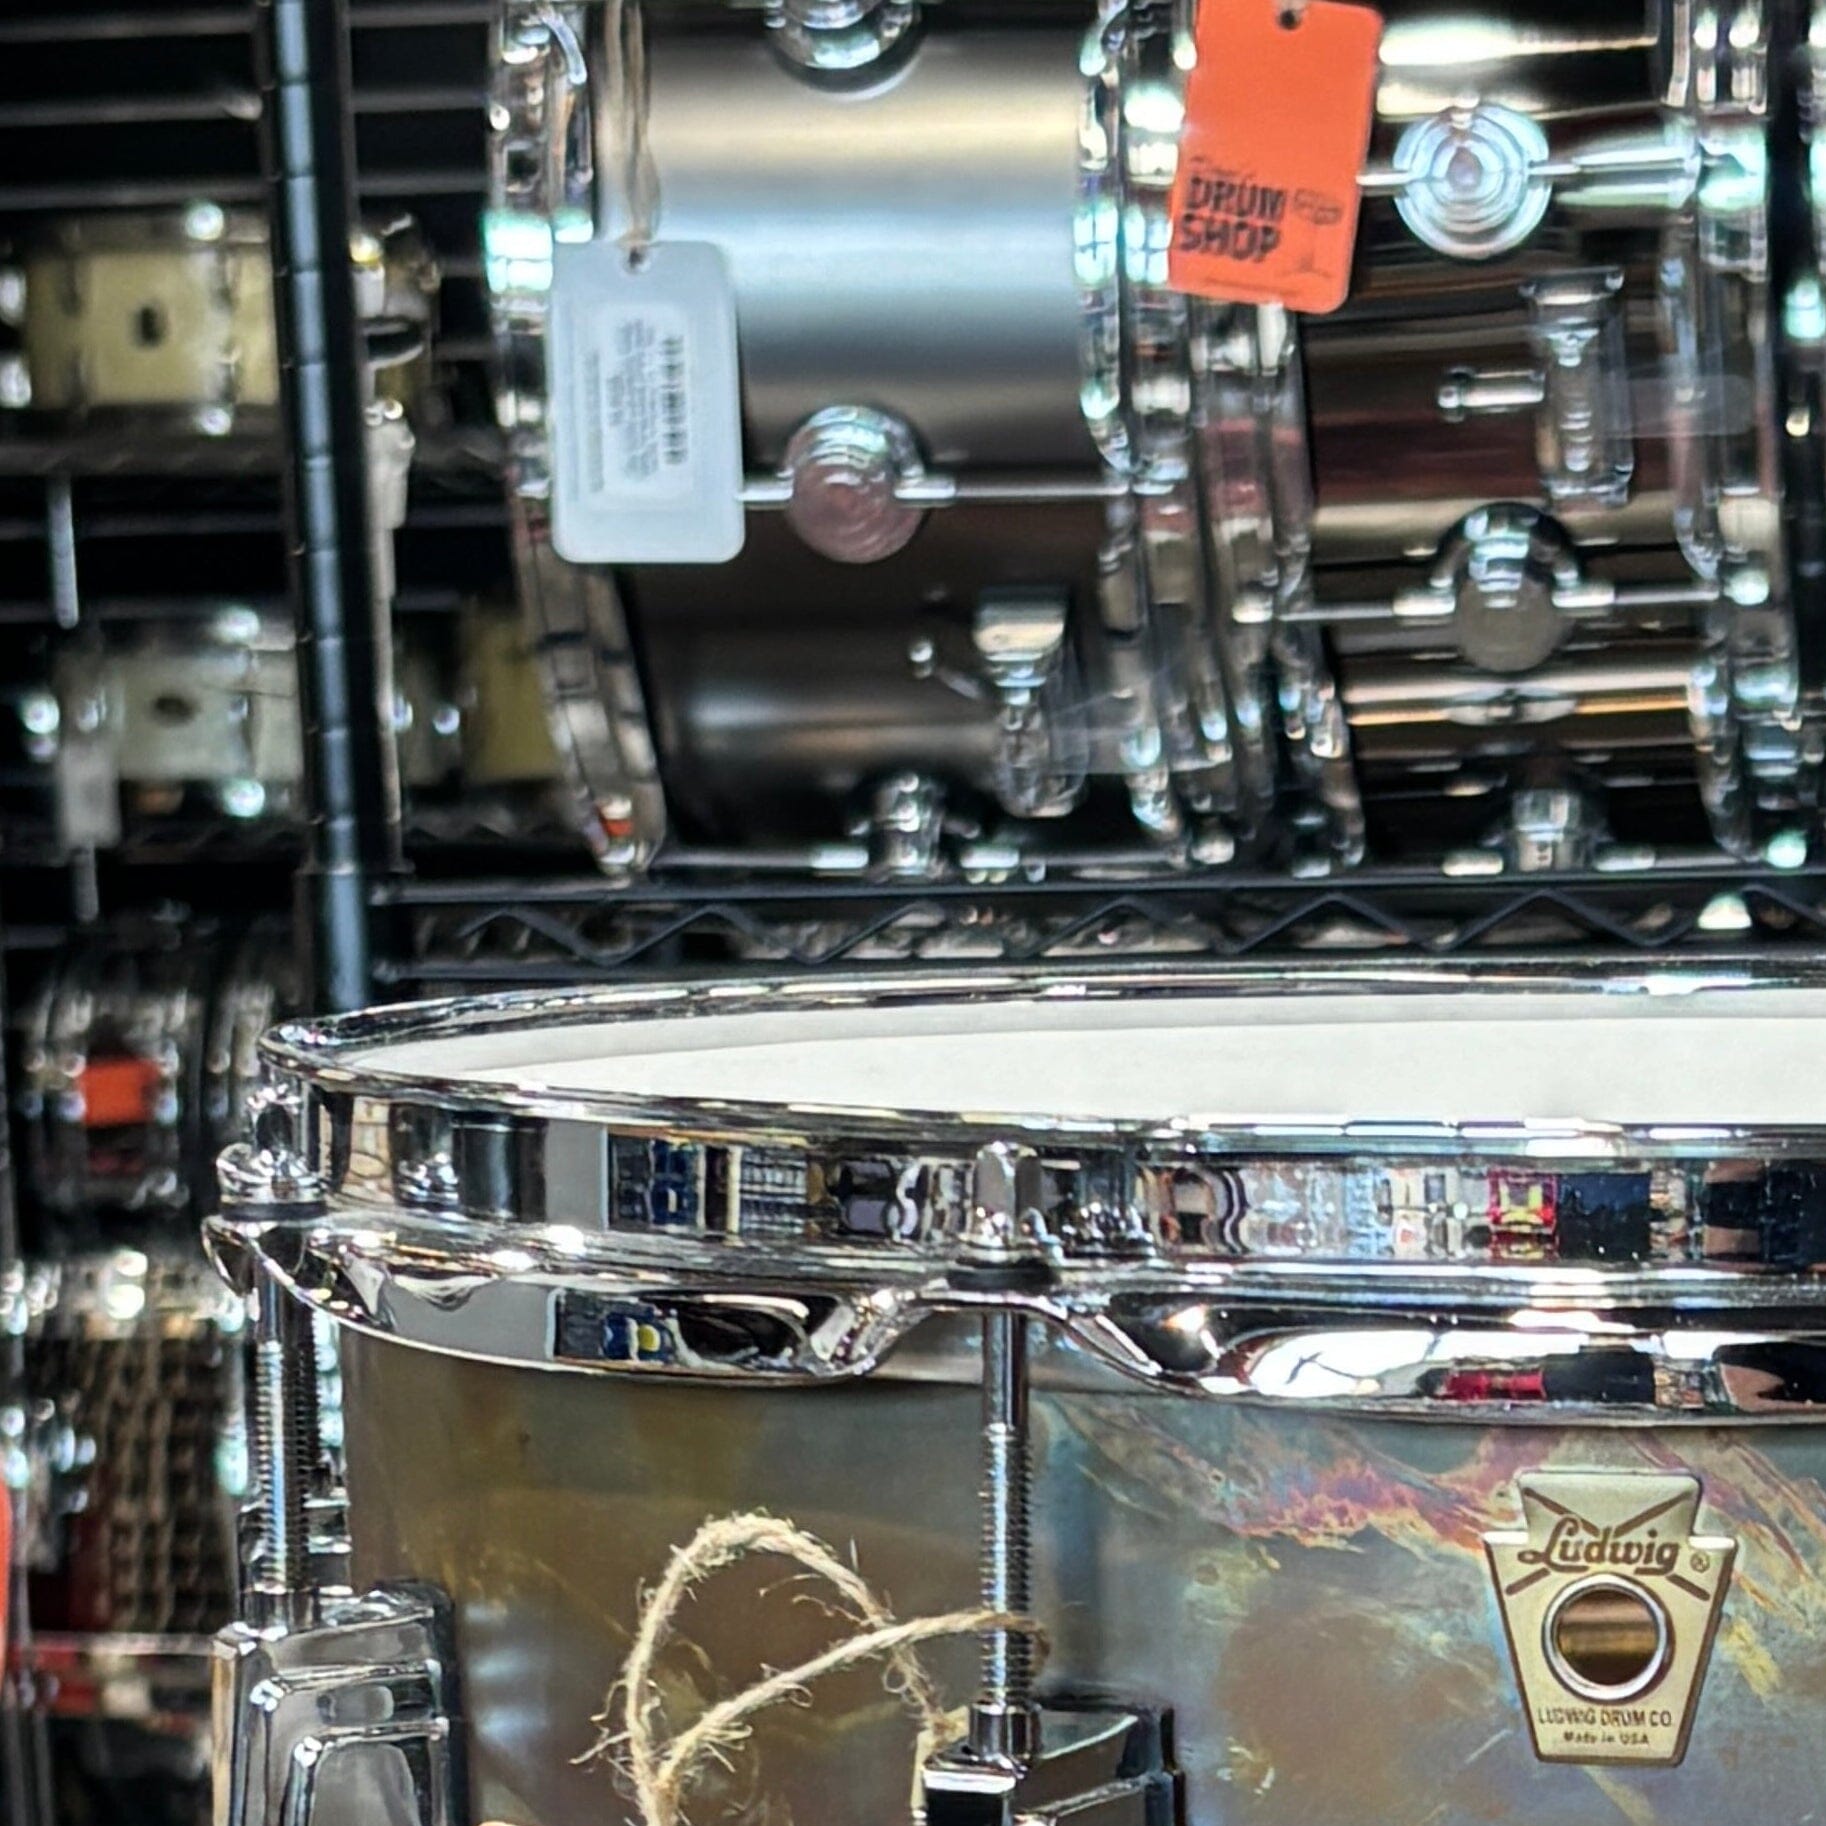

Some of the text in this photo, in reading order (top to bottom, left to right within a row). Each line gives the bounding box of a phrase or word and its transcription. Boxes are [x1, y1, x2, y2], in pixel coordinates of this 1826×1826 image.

[1186, 176, 1286, 223] DRUM
[1181, 212, 1281, 262] SHOP
[1517, 1517, 1679, 1576] Ludwig
[1600, 1709, 1646, 1727] DRUM
